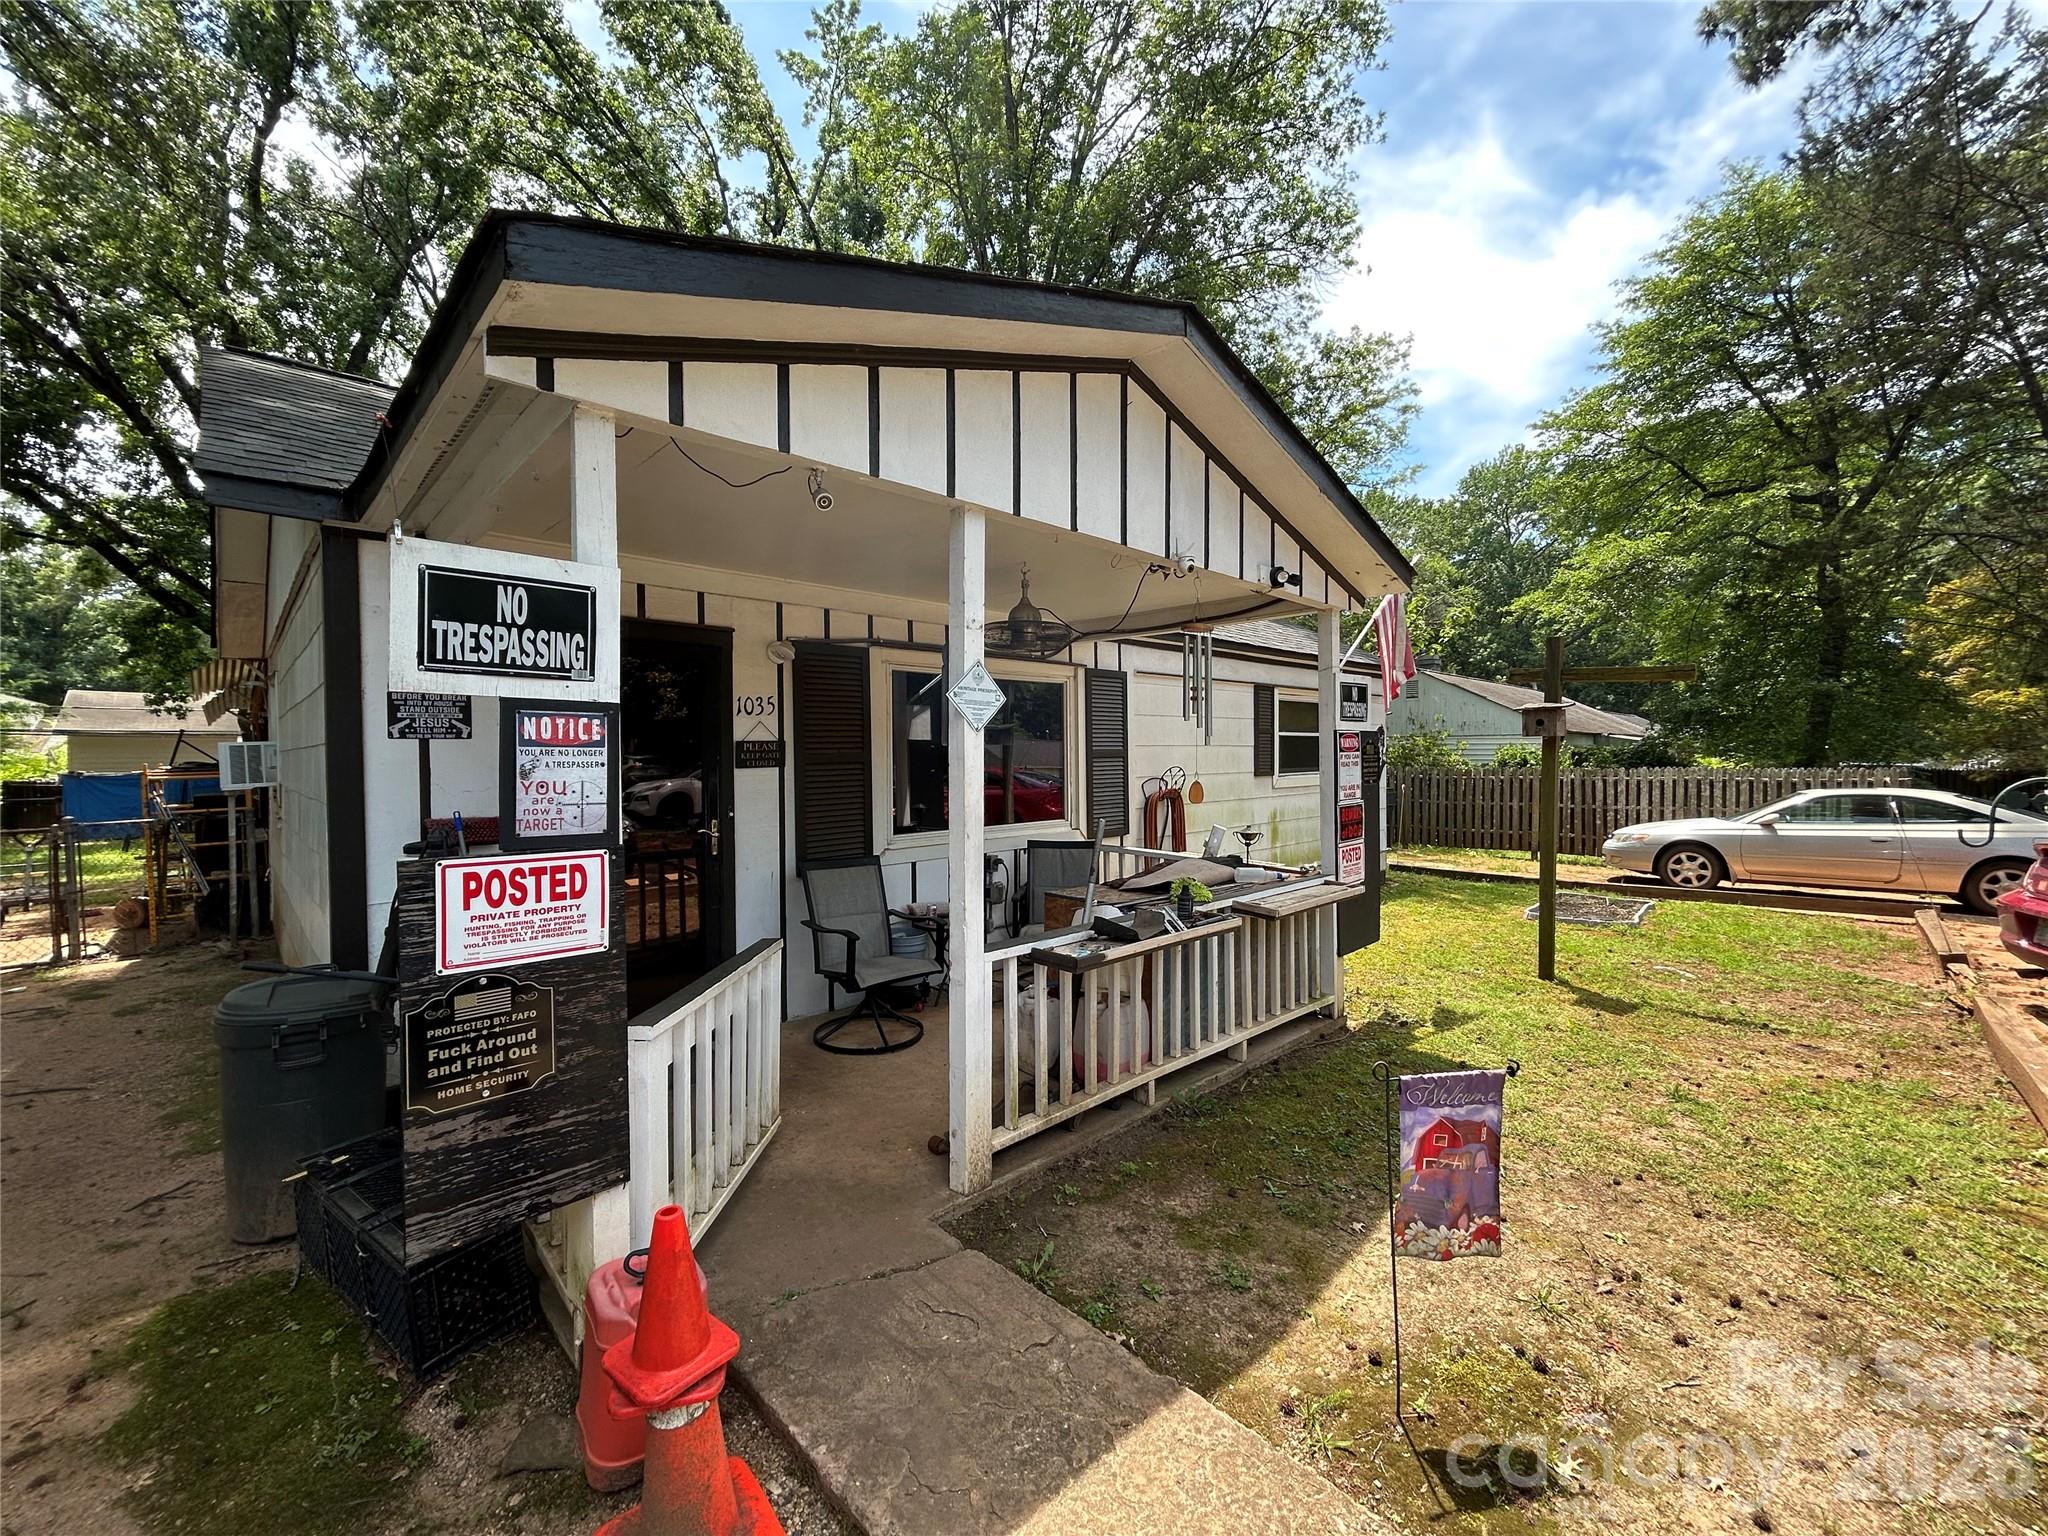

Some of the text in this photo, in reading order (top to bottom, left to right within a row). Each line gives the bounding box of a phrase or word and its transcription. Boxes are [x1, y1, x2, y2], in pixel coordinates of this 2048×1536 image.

[497, 585, 528, 624] NO
[432, 620, 584, 669] TRESPASSING
[736, 696, 775, 716] 1035
[1343, 702, 1366, 717] TRESPASSING
[412, 718, 449, 727] JESUS
[523, 716, 601, 741] NOTICE
[744, 742, 778, 751] PLEASE
[1340, 738, 1359, 747] WARNING
[519, 749, 537, 757] YOU
[539, 749, 555, 757] ARE
[520, 781, 567, 796] YOU
[532, 797, 554, 805] are
[523, 808, 550, 816] now
[517, 818, 564, 831] TARGET
[1342, 846, 1361, 864] POSTED
[462, 864, 588, 911] POSTED
[470, 904, 581, 923] PRIVATE PROPERTY
[464, 923, 502, 932] HUNTING,
[504, 920, 536, 928] FISHING,
[539, 915, 574, 923] TRAPPING
[466, 928, 518, 938] TRESPASSING
[554, 919, 586, 927] PURPOSE
[491, 932, 528, 940] STRICTLY
[531, 926, 572, 935] FORBIDDEN
[464, 940, 508, 950] VIOLATORS
[541, 929, 588, 939] PROSECUTED
[427, 1010, 537, 1038] PROTECTED BY: FAFO
[428, 1028, 536, 1062] Fuck Around
[427, 1043, 538, 1078] and Find Out
[438, 1070, 529, 1099] HOME SECURITY
[1406, 1080, 1498, 1106] Welcome
